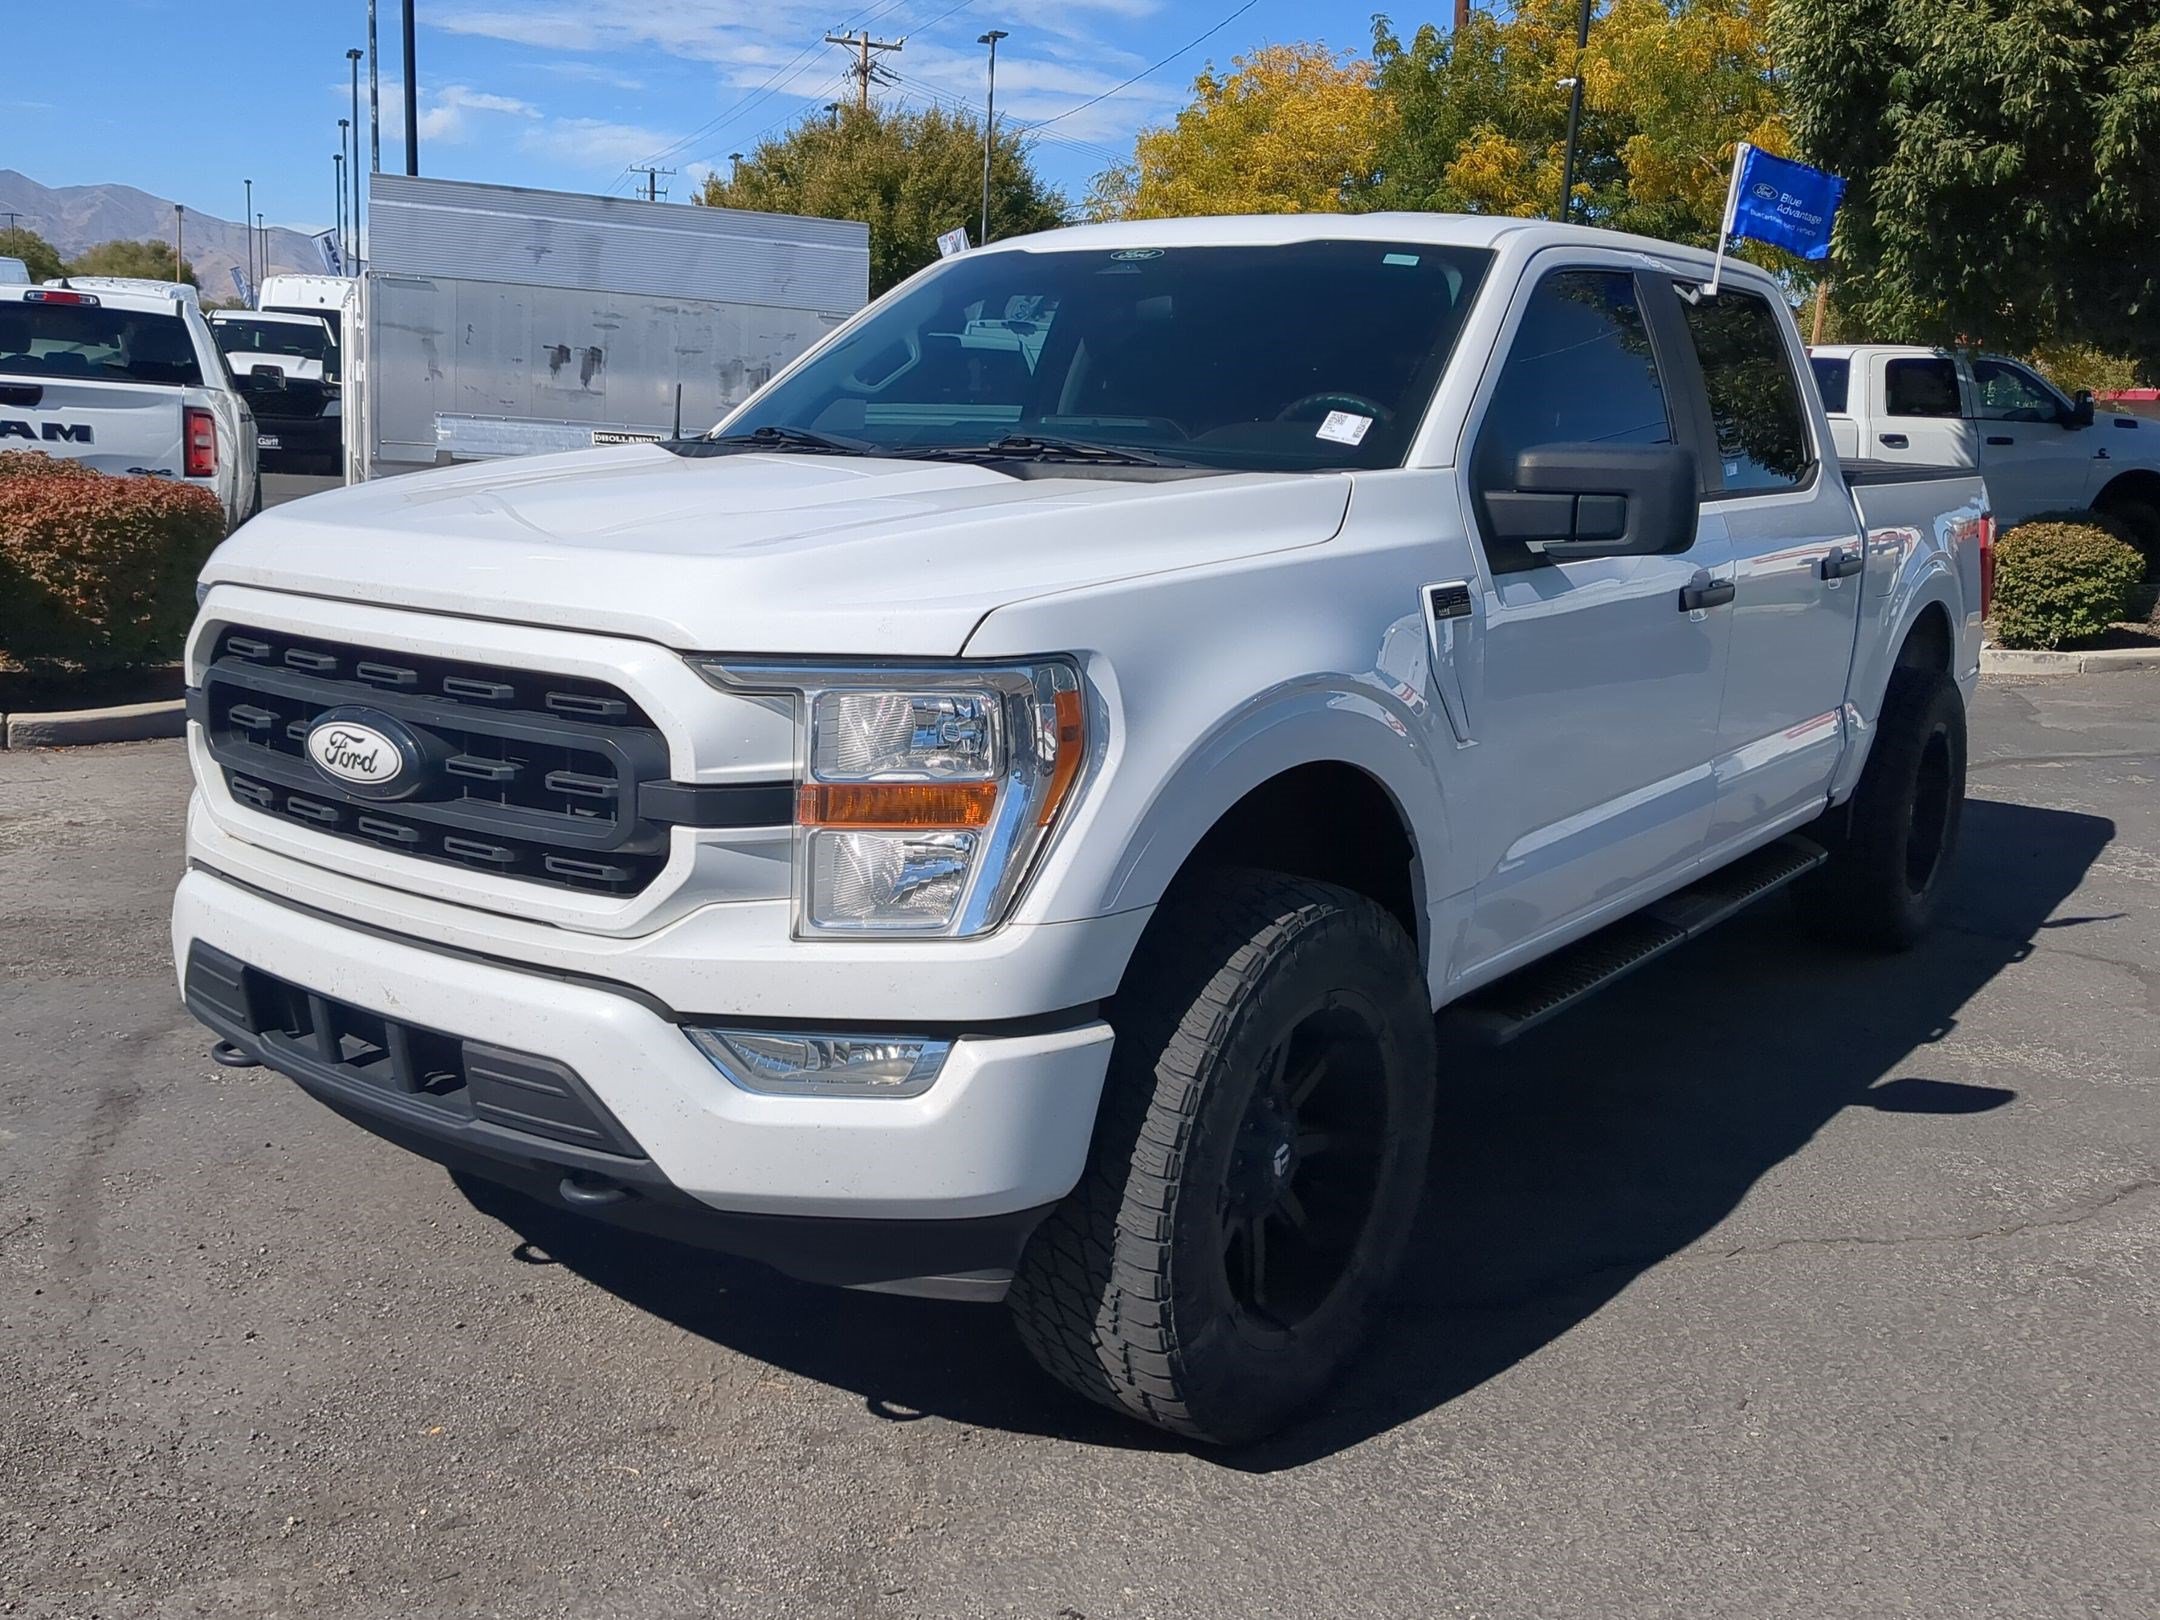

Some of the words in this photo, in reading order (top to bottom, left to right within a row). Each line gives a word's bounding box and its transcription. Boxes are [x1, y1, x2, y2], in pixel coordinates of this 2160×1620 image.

[1780, 193, 1803, 208] Blue
[1776, 203, 1823, 225] Advantage
[0, 420, 94, 445] AM
[325, 730, 379, 774] Ford
